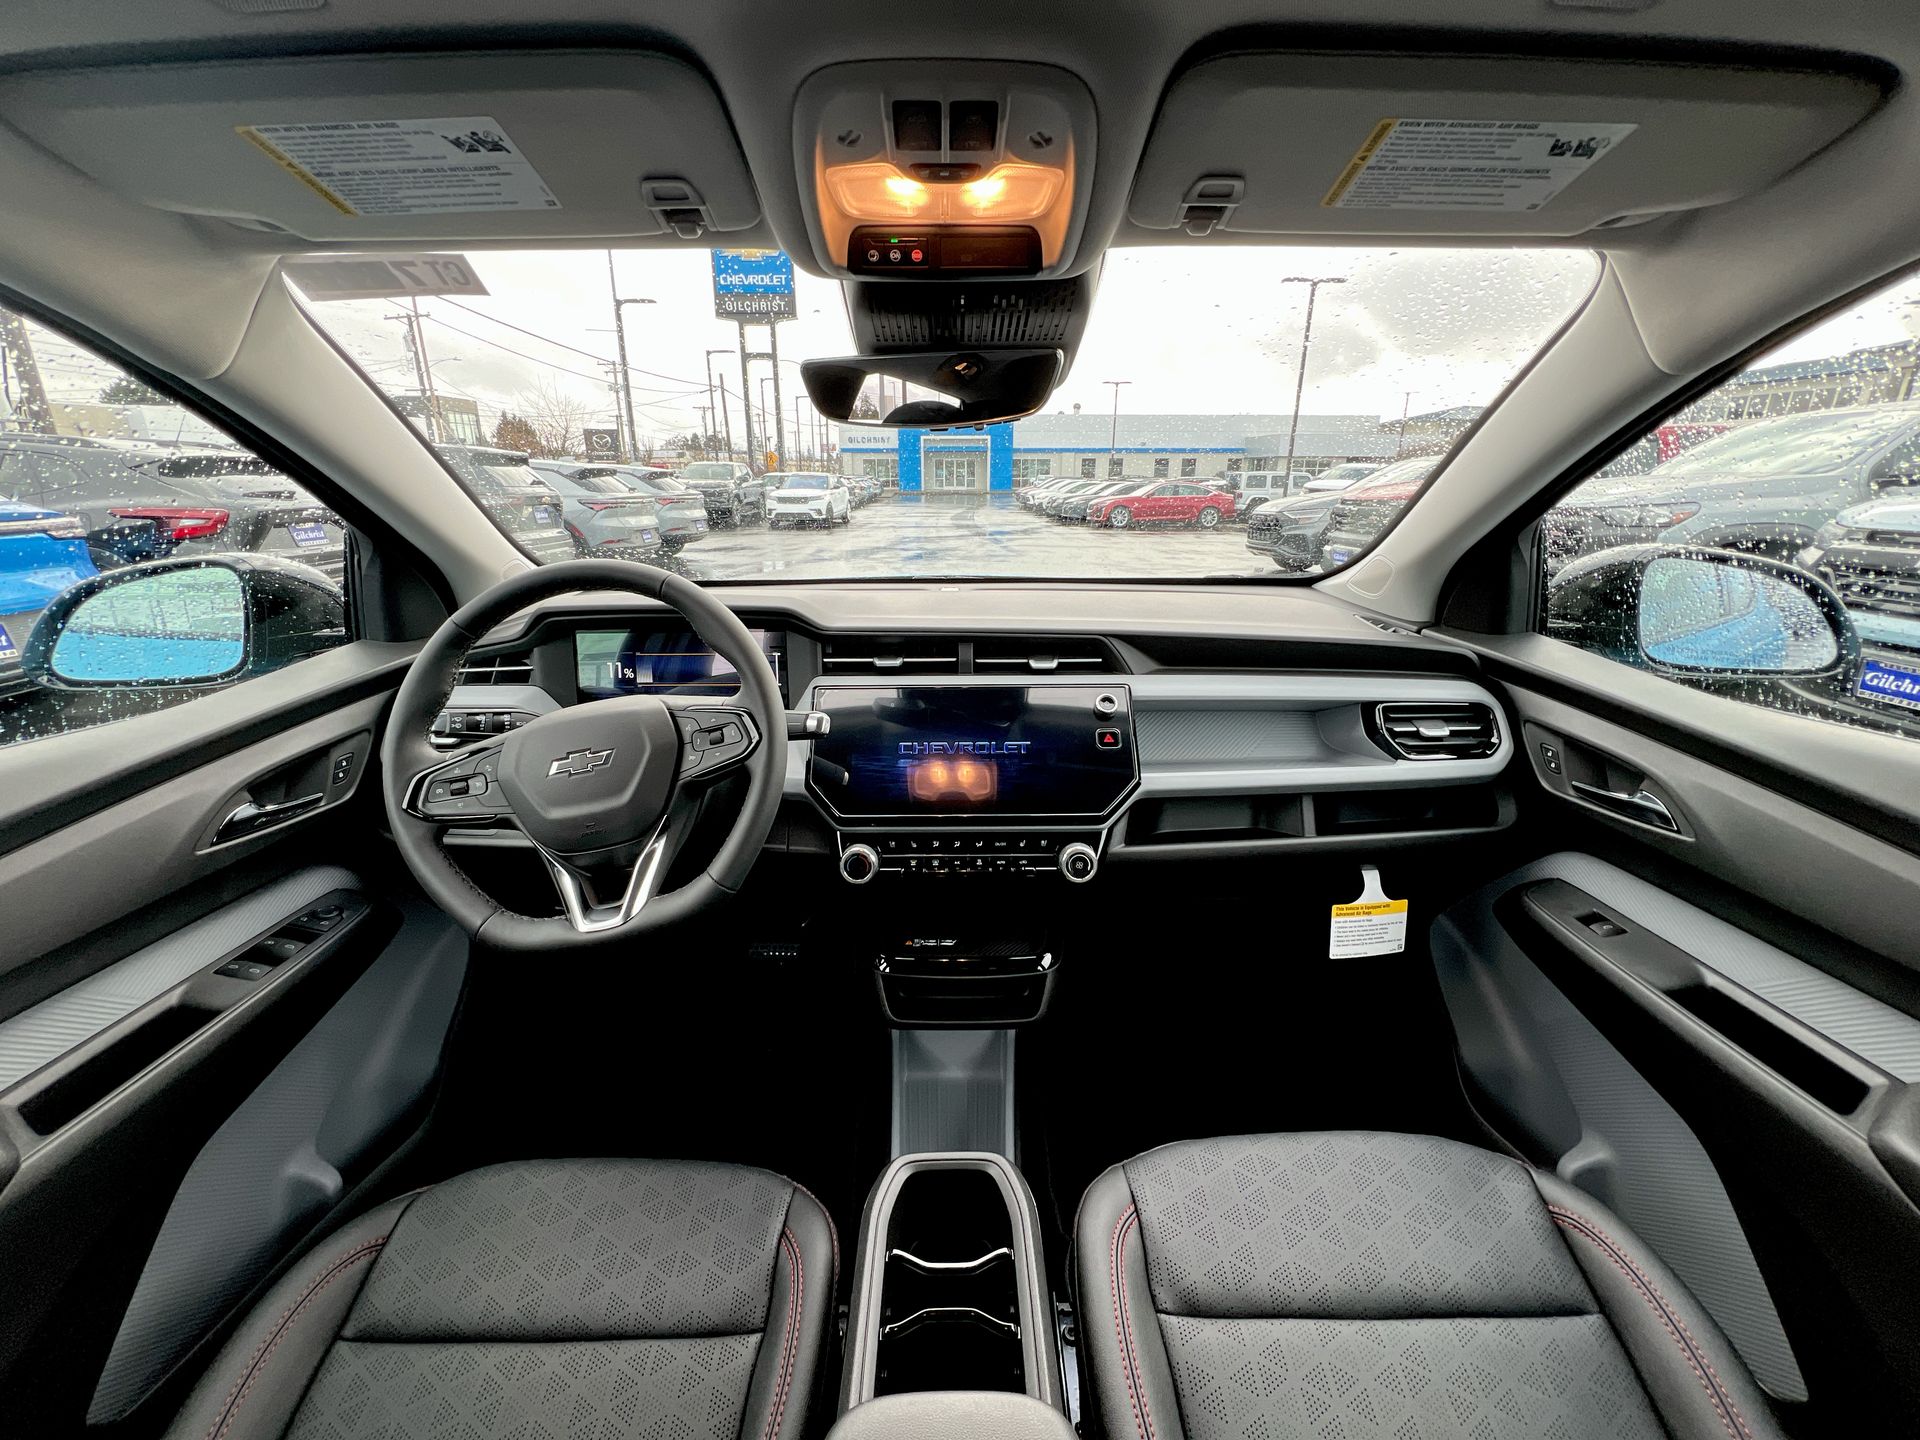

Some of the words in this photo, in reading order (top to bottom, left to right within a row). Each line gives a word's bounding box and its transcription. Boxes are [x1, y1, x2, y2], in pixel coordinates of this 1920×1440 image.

[720, 273, 787, 285] CHEVROLET
[725, 300, 785, 312] GILCHRIST
[294, 530, 325, 540] Gilchrist
[898, 741, 1031, 755] CHEVROLET
